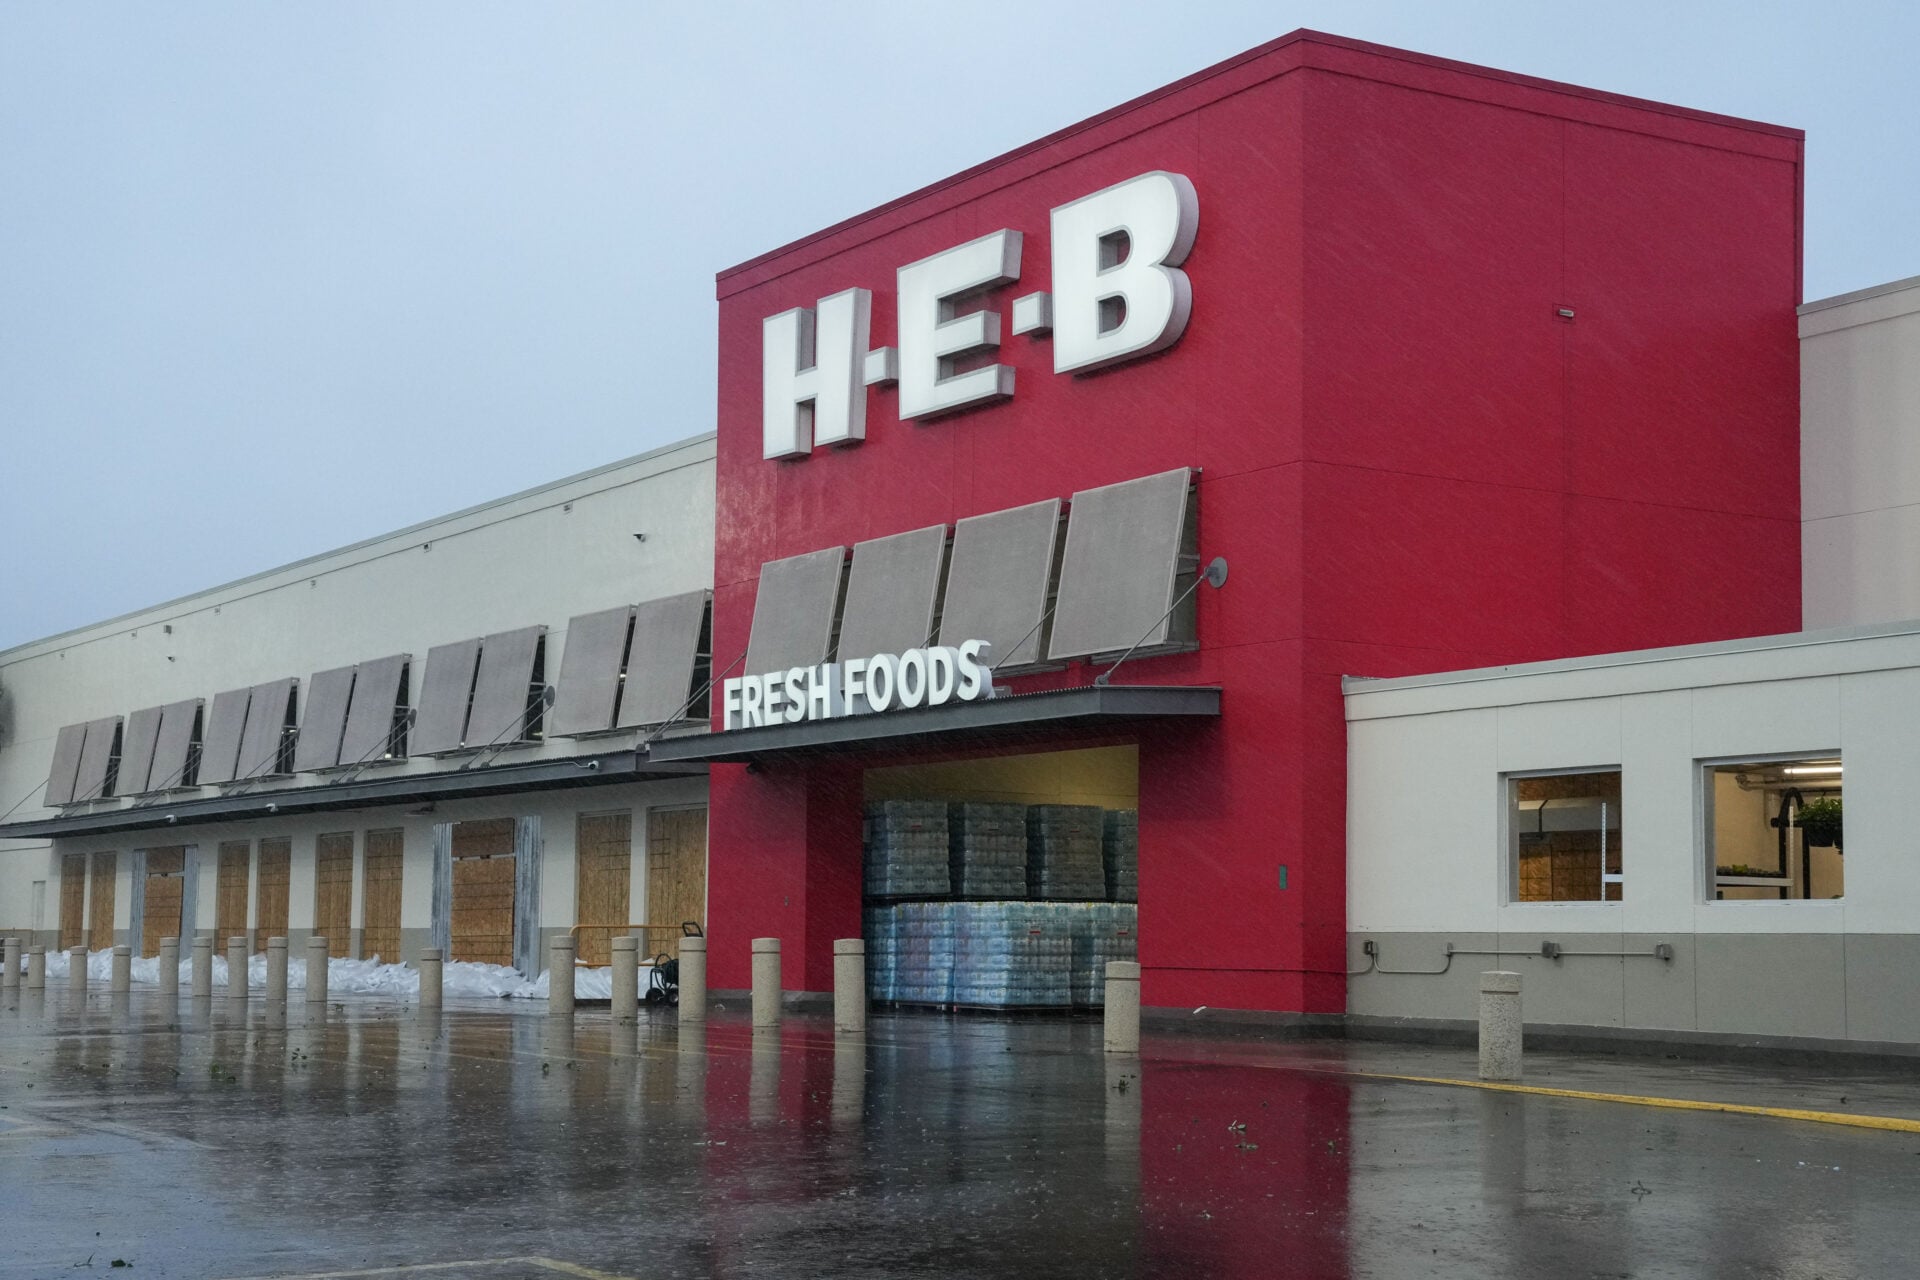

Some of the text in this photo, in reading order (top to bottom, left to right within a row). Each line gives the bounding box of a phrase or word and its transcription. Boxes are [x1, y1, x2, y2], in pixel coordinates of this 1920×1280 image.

[762, 170, 1200, 461] H-E-B
[723, 639, 992, 731] FRESH FOODS
